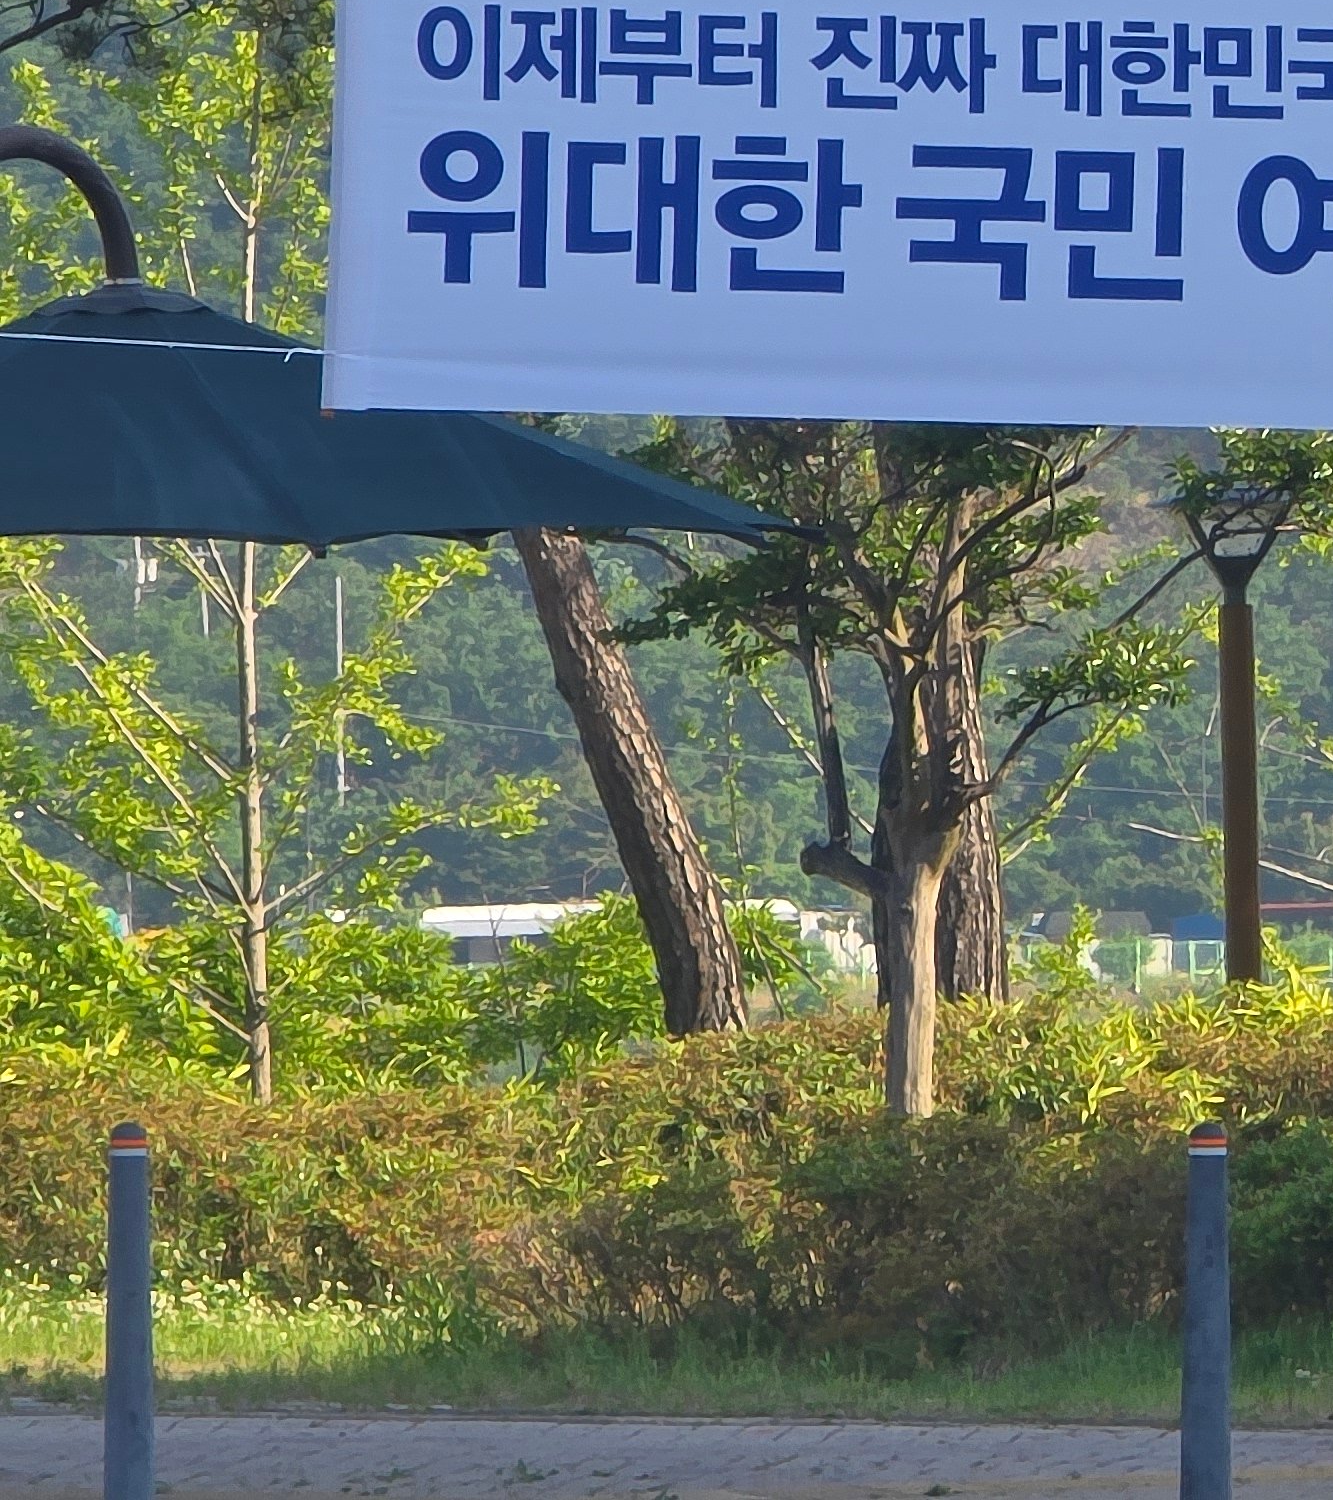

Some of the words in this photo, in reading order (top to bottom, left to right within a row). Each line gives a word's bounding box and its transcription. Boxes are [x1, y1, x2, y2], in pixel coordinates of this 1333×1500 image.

[417, 4, 778, 109] 이제부터
[808, 15, 997, 114] 진짜
[407, 130, 863, 294] 위대한
[895, 144, 1185, 302] 국민
